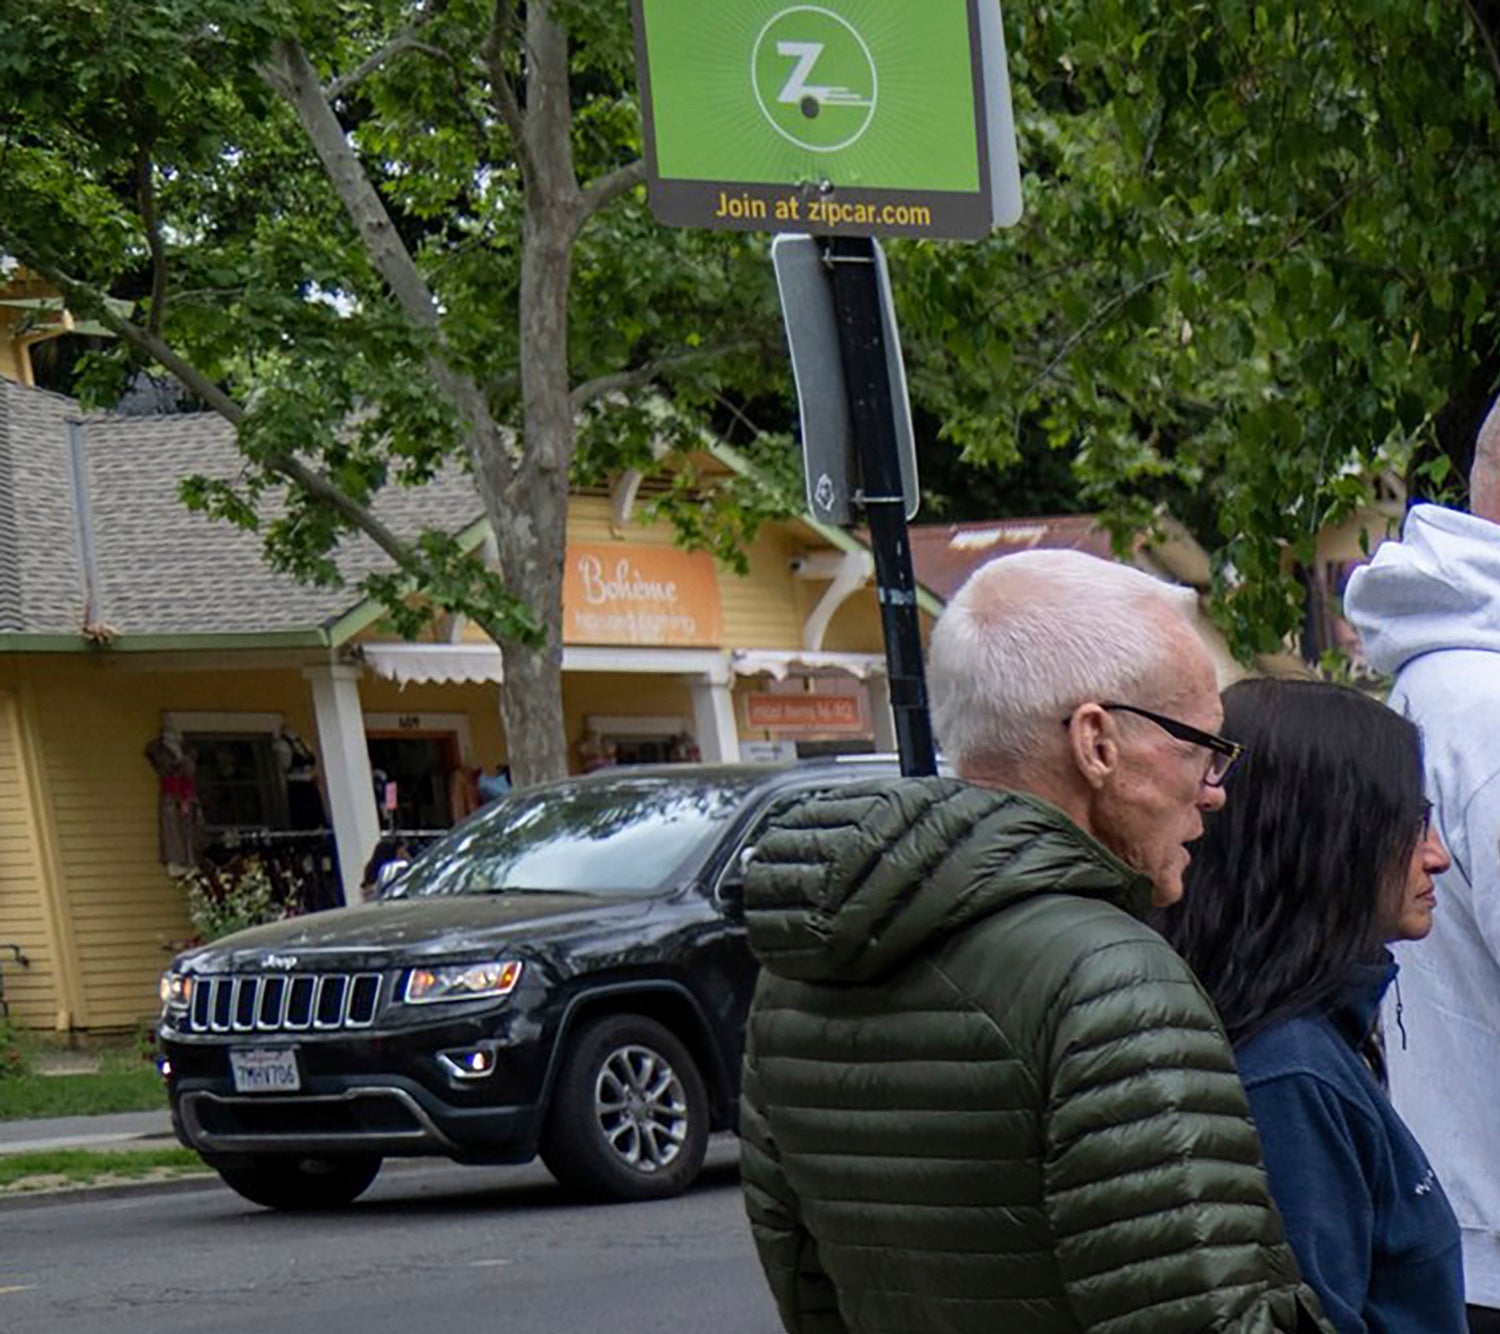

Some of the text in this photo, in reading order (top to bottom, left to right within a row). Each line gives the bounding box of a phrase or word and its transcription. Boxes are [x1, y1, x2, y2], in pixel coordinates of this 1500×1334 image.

[716, 193, 932, 227] Join at zipcar.com
[262, 954, 297, 970] Jeep
